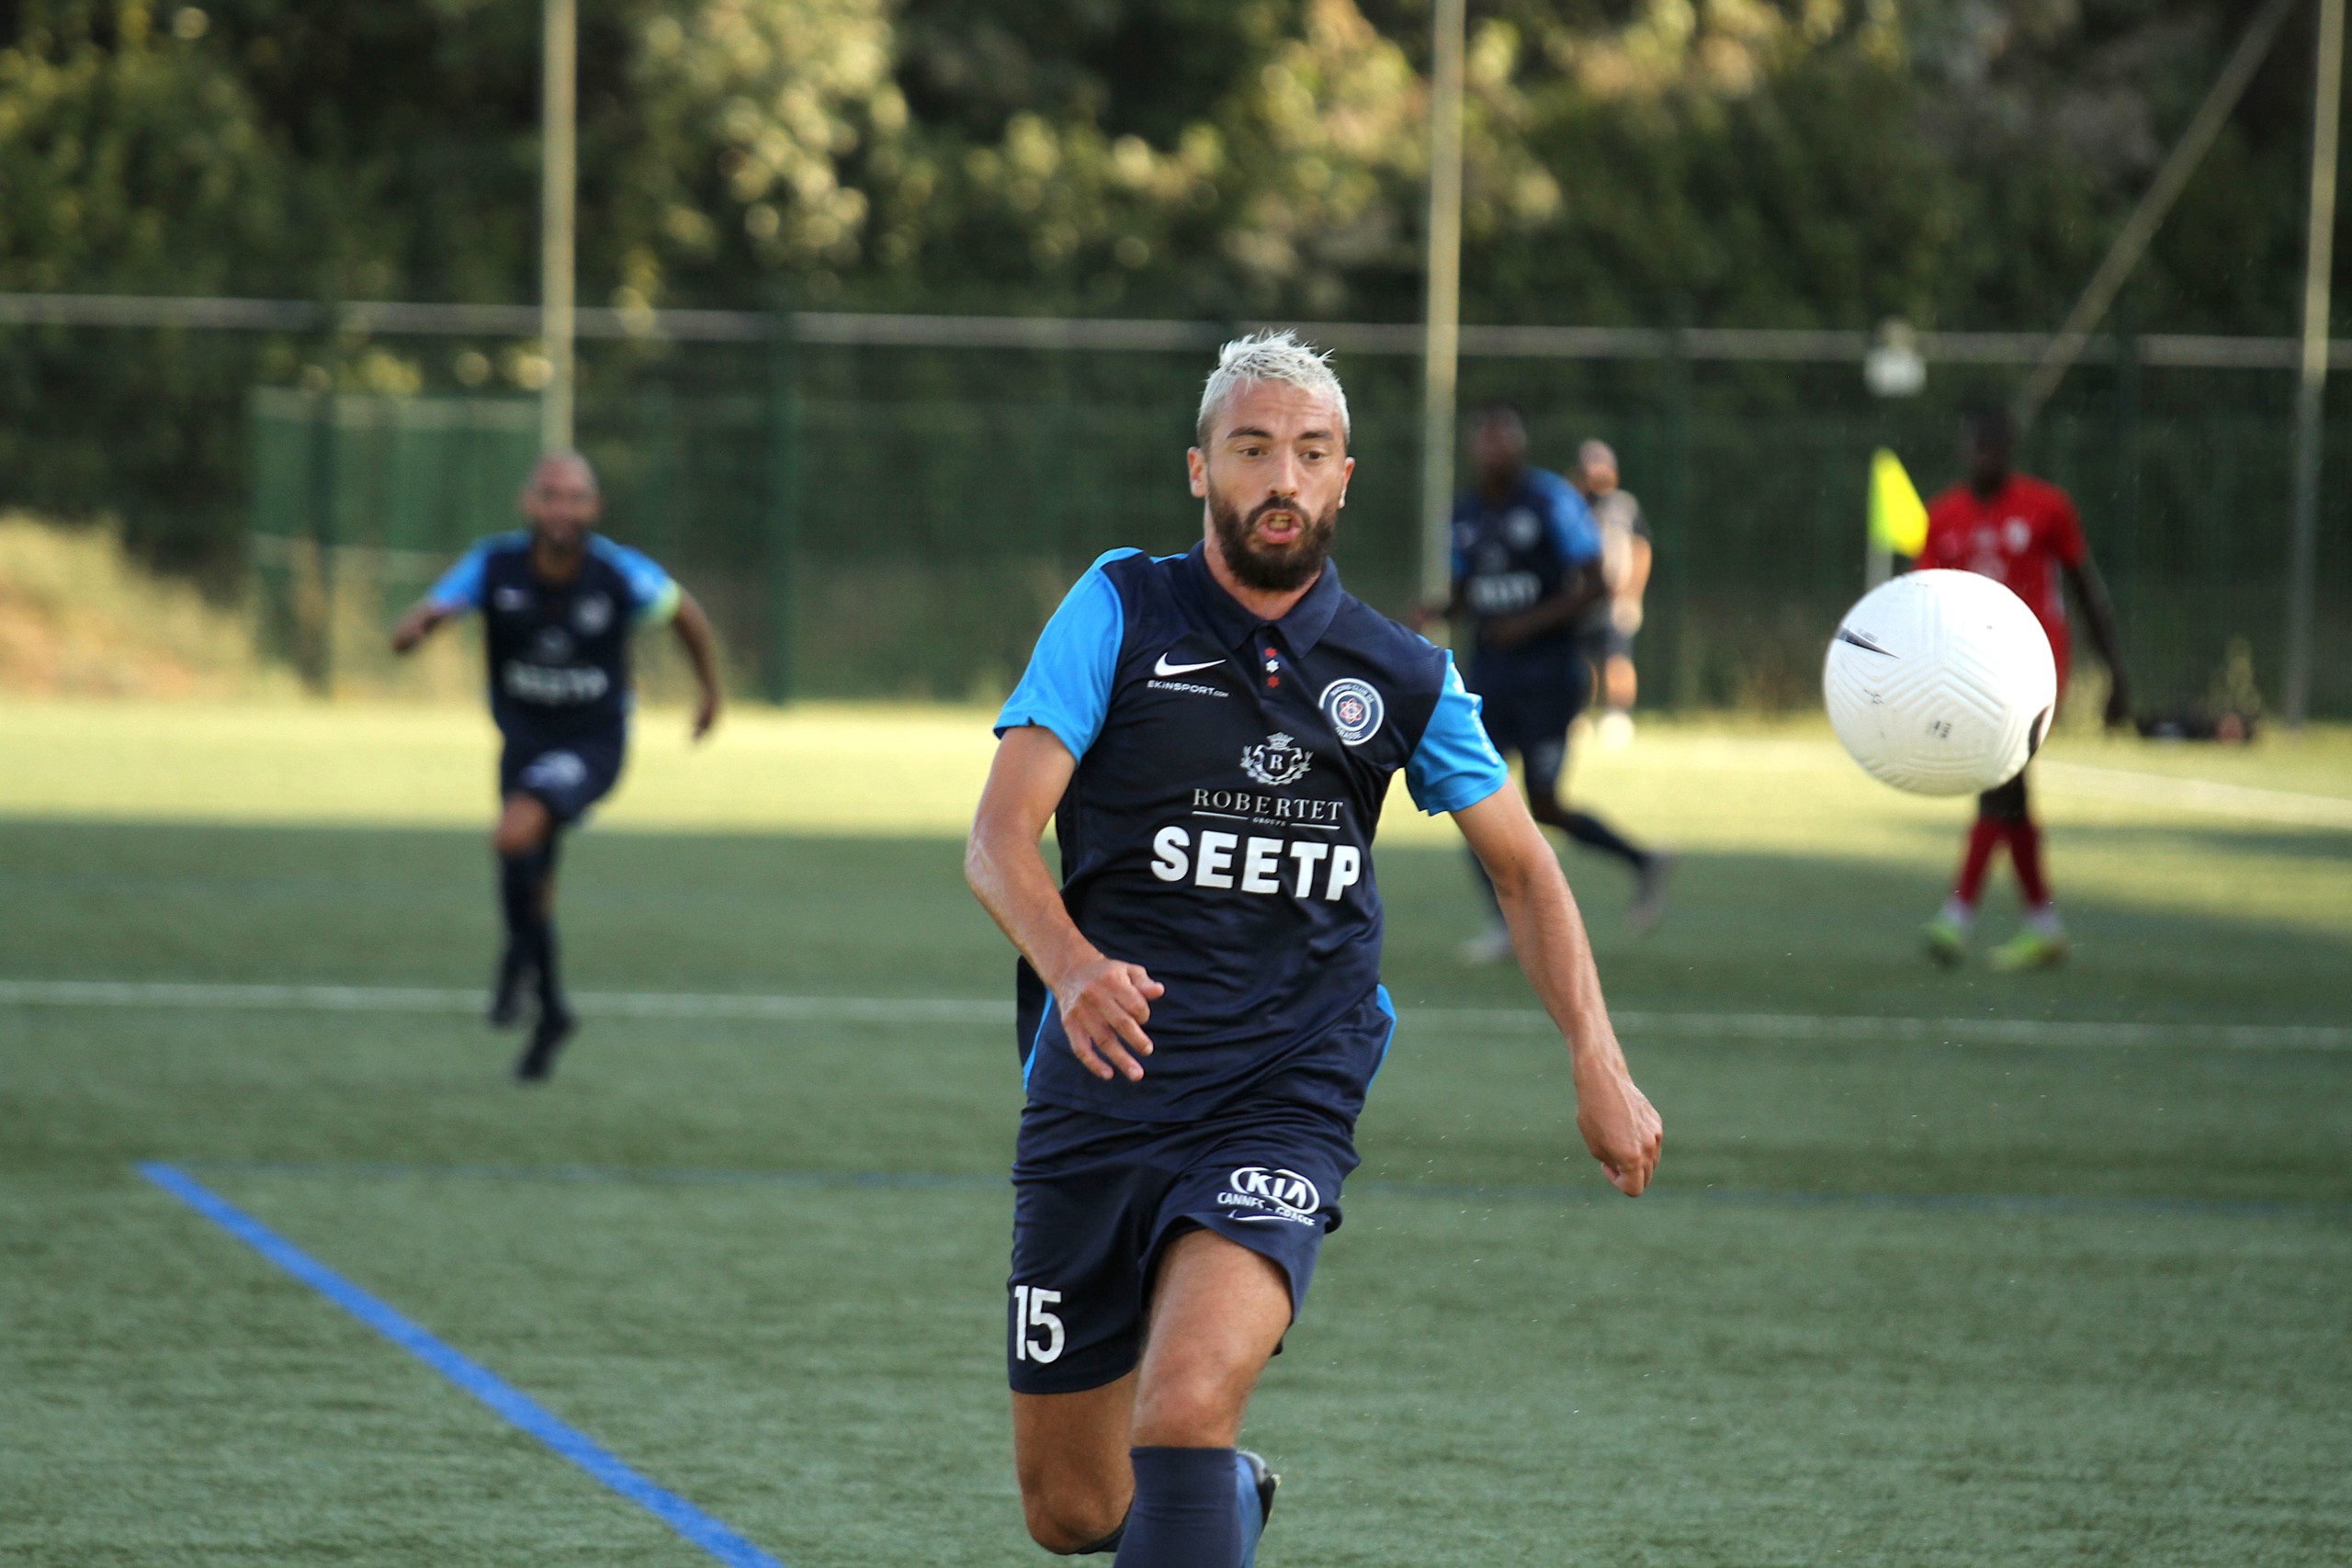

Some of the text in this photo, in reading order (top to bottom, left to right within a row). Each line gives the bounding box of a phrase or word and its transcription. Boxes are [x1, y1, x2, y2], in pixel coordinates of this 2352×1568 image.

[1269, 753, 1284, 770] R
[1193, 788, 1344, 821] ROBERTET
[1150, 826, 1362, 901] SEETP
[1246, 1171, 1306, 1208] KIA
[1014, 1285, 1066, 1364] 15
